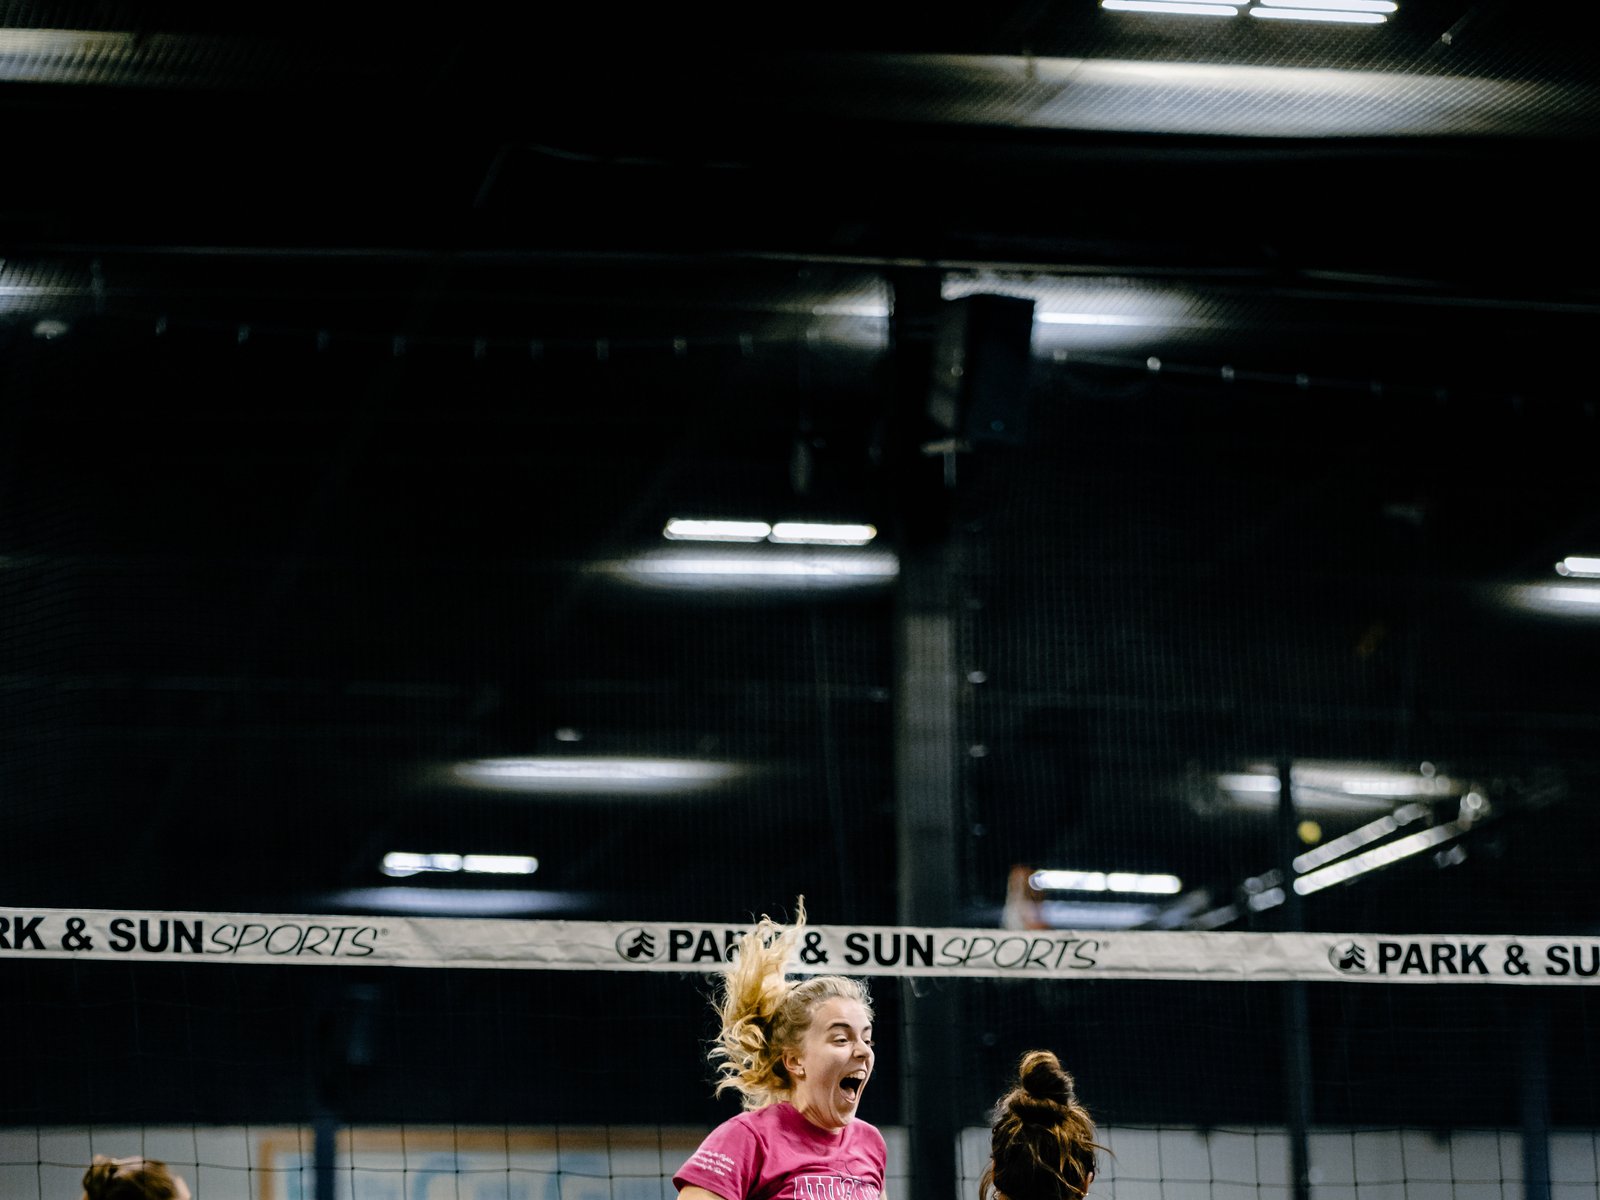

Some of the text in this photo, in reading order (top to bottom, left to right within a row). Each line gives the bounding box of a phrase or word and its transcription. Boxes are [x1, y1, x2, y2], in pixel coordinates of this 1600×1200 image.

[61, 917, 94, 952] &
[108, 918, 203, 954] SUN
[669, 929, 783, 963] PAR
[800, 931, 828, 965] &
[844, 933, 933, 967] SUN
[1378, 942, 1600, 977] PARK & SU
